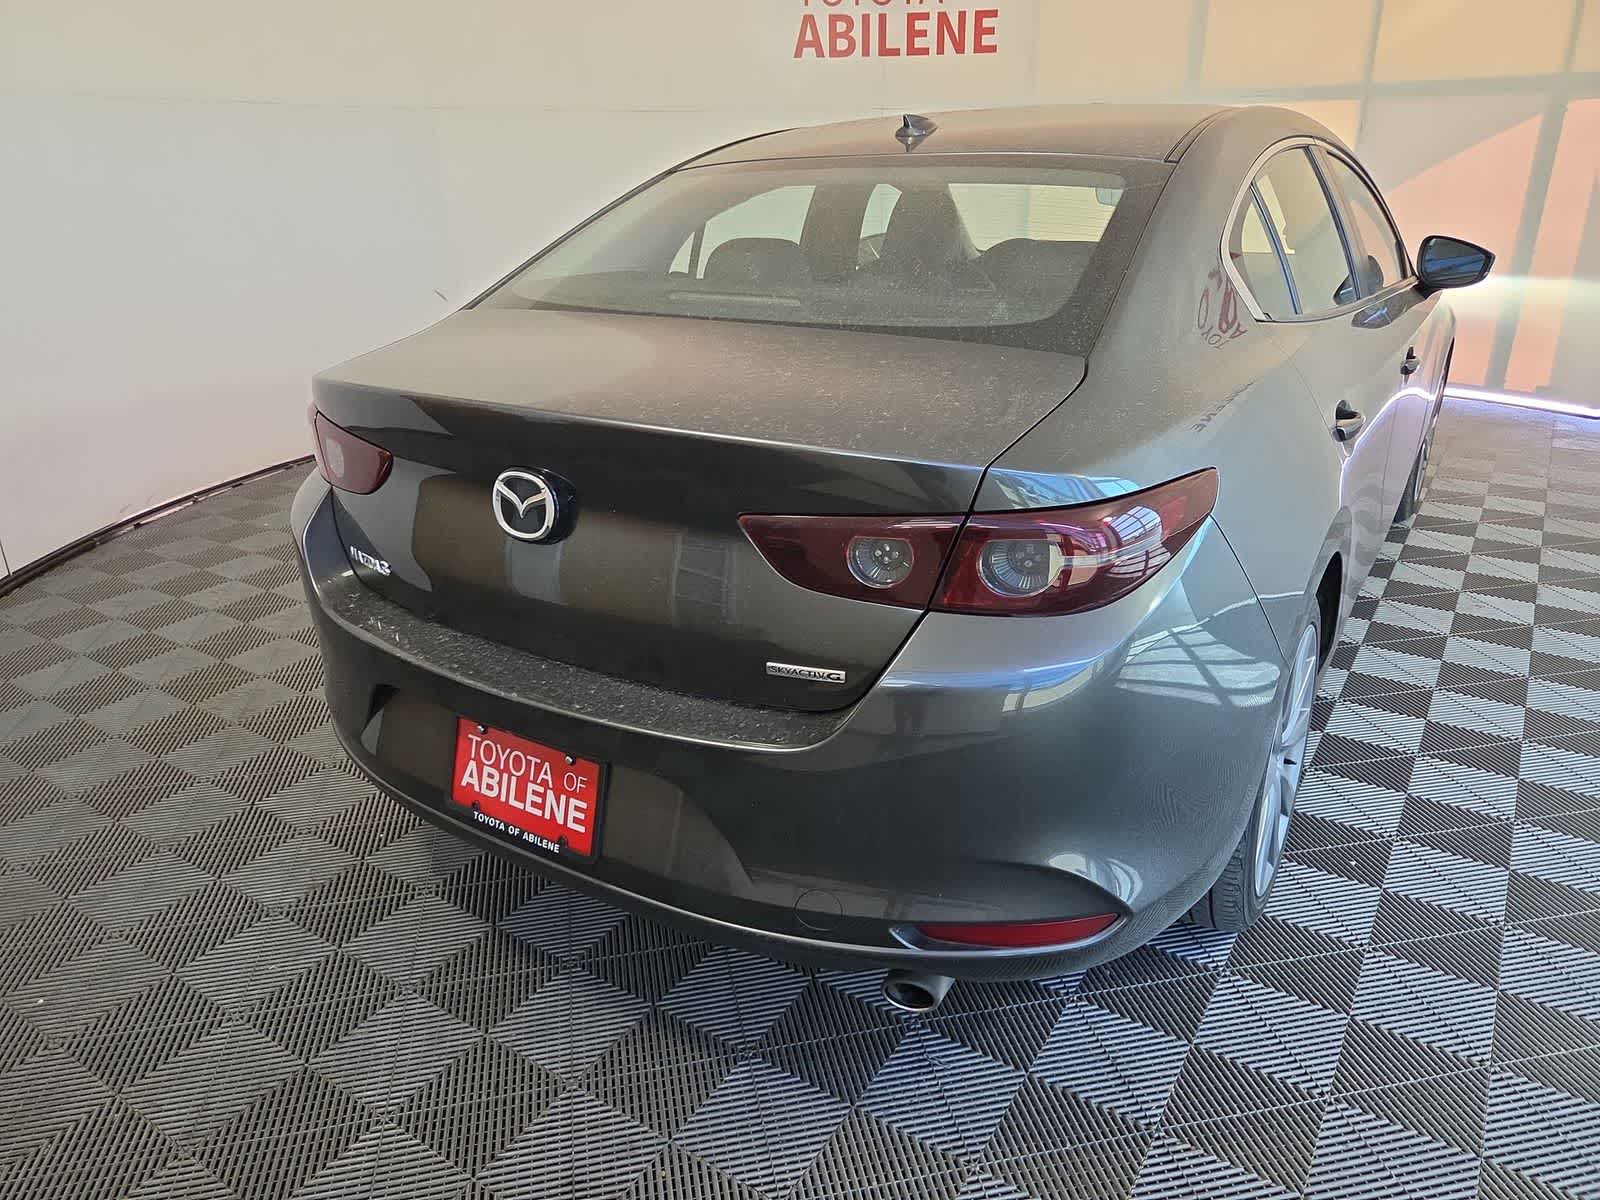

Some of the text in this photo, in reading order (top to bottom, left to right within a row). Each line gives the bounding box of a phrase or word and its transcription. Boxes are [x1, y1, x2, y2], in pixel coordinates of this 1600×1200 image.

[793, 9, 998, 58] ABILENE
[468, 734, 588, 793] TOYOTA OF
[461, 760, 588, 833] ABILENE
[473, 811, 560, 853] TOYOTA OF ABILENE
